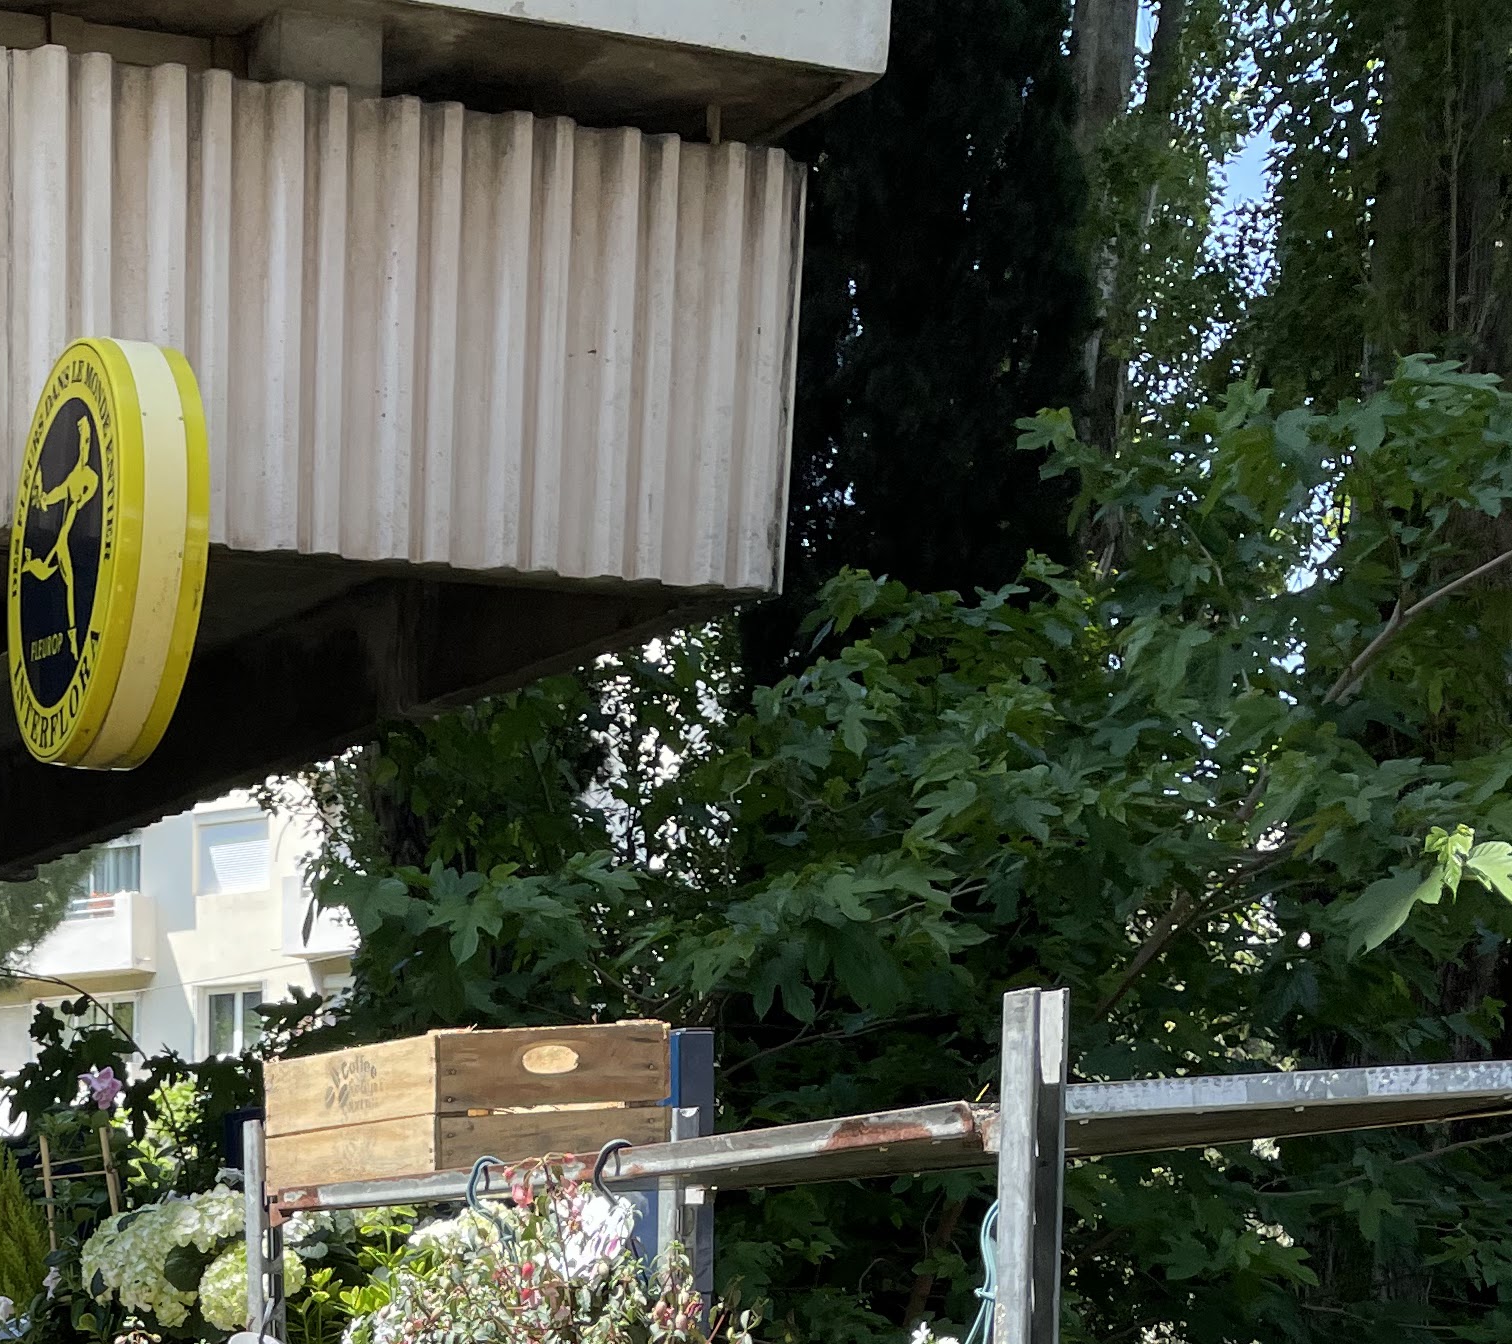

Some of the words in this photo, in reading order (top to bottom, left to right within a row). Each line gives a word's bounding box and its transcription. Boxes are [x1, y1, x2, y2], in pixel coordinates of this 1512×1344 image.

[45, 364, 70, 418] DANS
[71, 360, 85, 384] LE
[85, 361, 111, 437] MONDE
[14, 631, 101, 749] INTERFLORA
